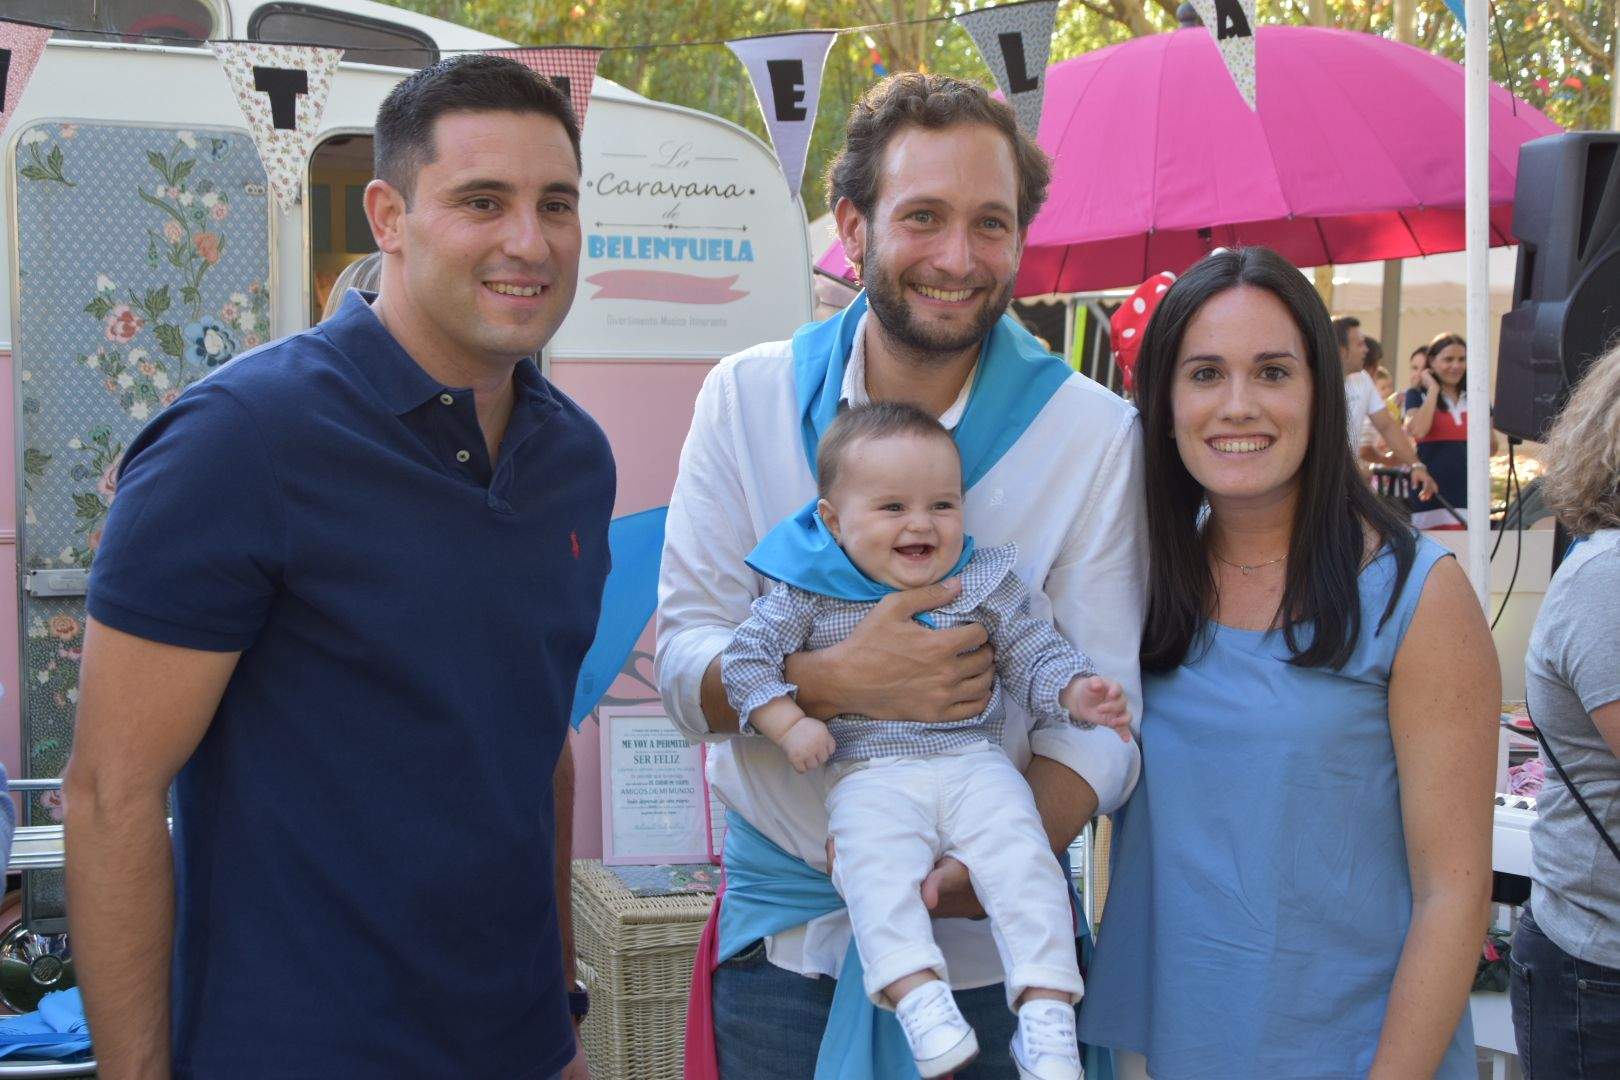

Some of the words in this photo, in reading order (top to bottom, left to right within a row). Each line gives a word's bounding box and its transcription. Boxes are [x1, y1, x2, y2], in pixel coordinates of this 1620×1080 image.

[252, 66, 308, 130] T
[766, 59, 807, 121] E
[997, 32, 1039, 94] L
[1214, 0, 1252, 40] A
[596, 172, 746, 198] Caravana
[587, 234, 754, 262] BELENTUELA
[633, 754, 651, 765] SER
[654, 754, 681, 764] FELIZ
